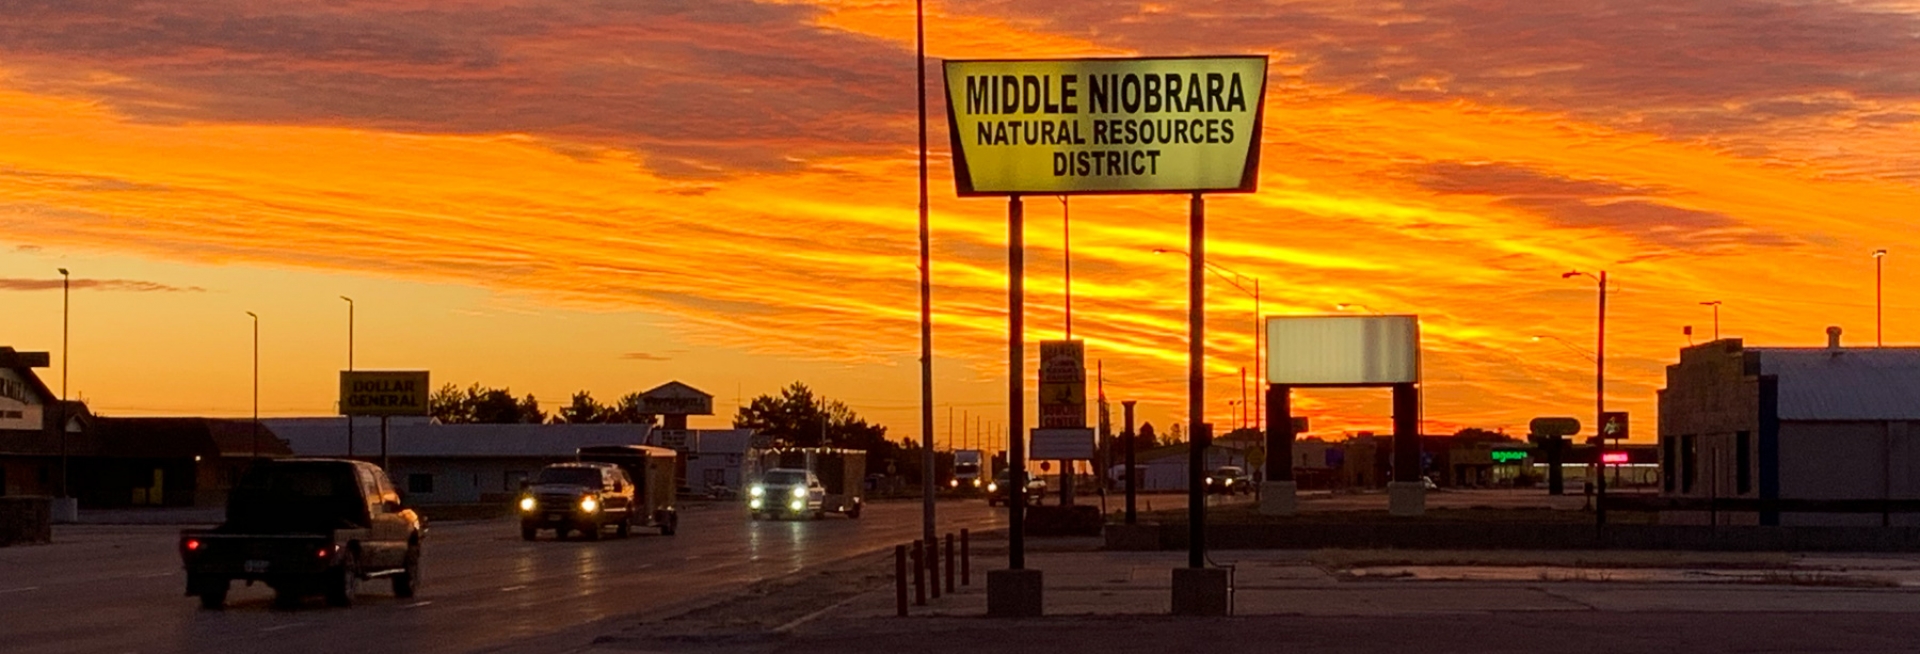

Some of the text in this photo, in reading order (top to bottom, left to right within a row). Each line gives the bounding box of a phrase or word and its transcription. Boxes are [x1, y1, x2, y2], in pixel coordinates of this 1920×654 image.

[966, 72, 1246, 115] MIDDLE NIOBRARA
[977, 119, 1234, 145] NATURAL RESOURCES
[1053, 150, 1160, 177] DISTRICT
[353, 380, 415, 392] DOLLAR
[348, 394, 419, 407] GENERAL
